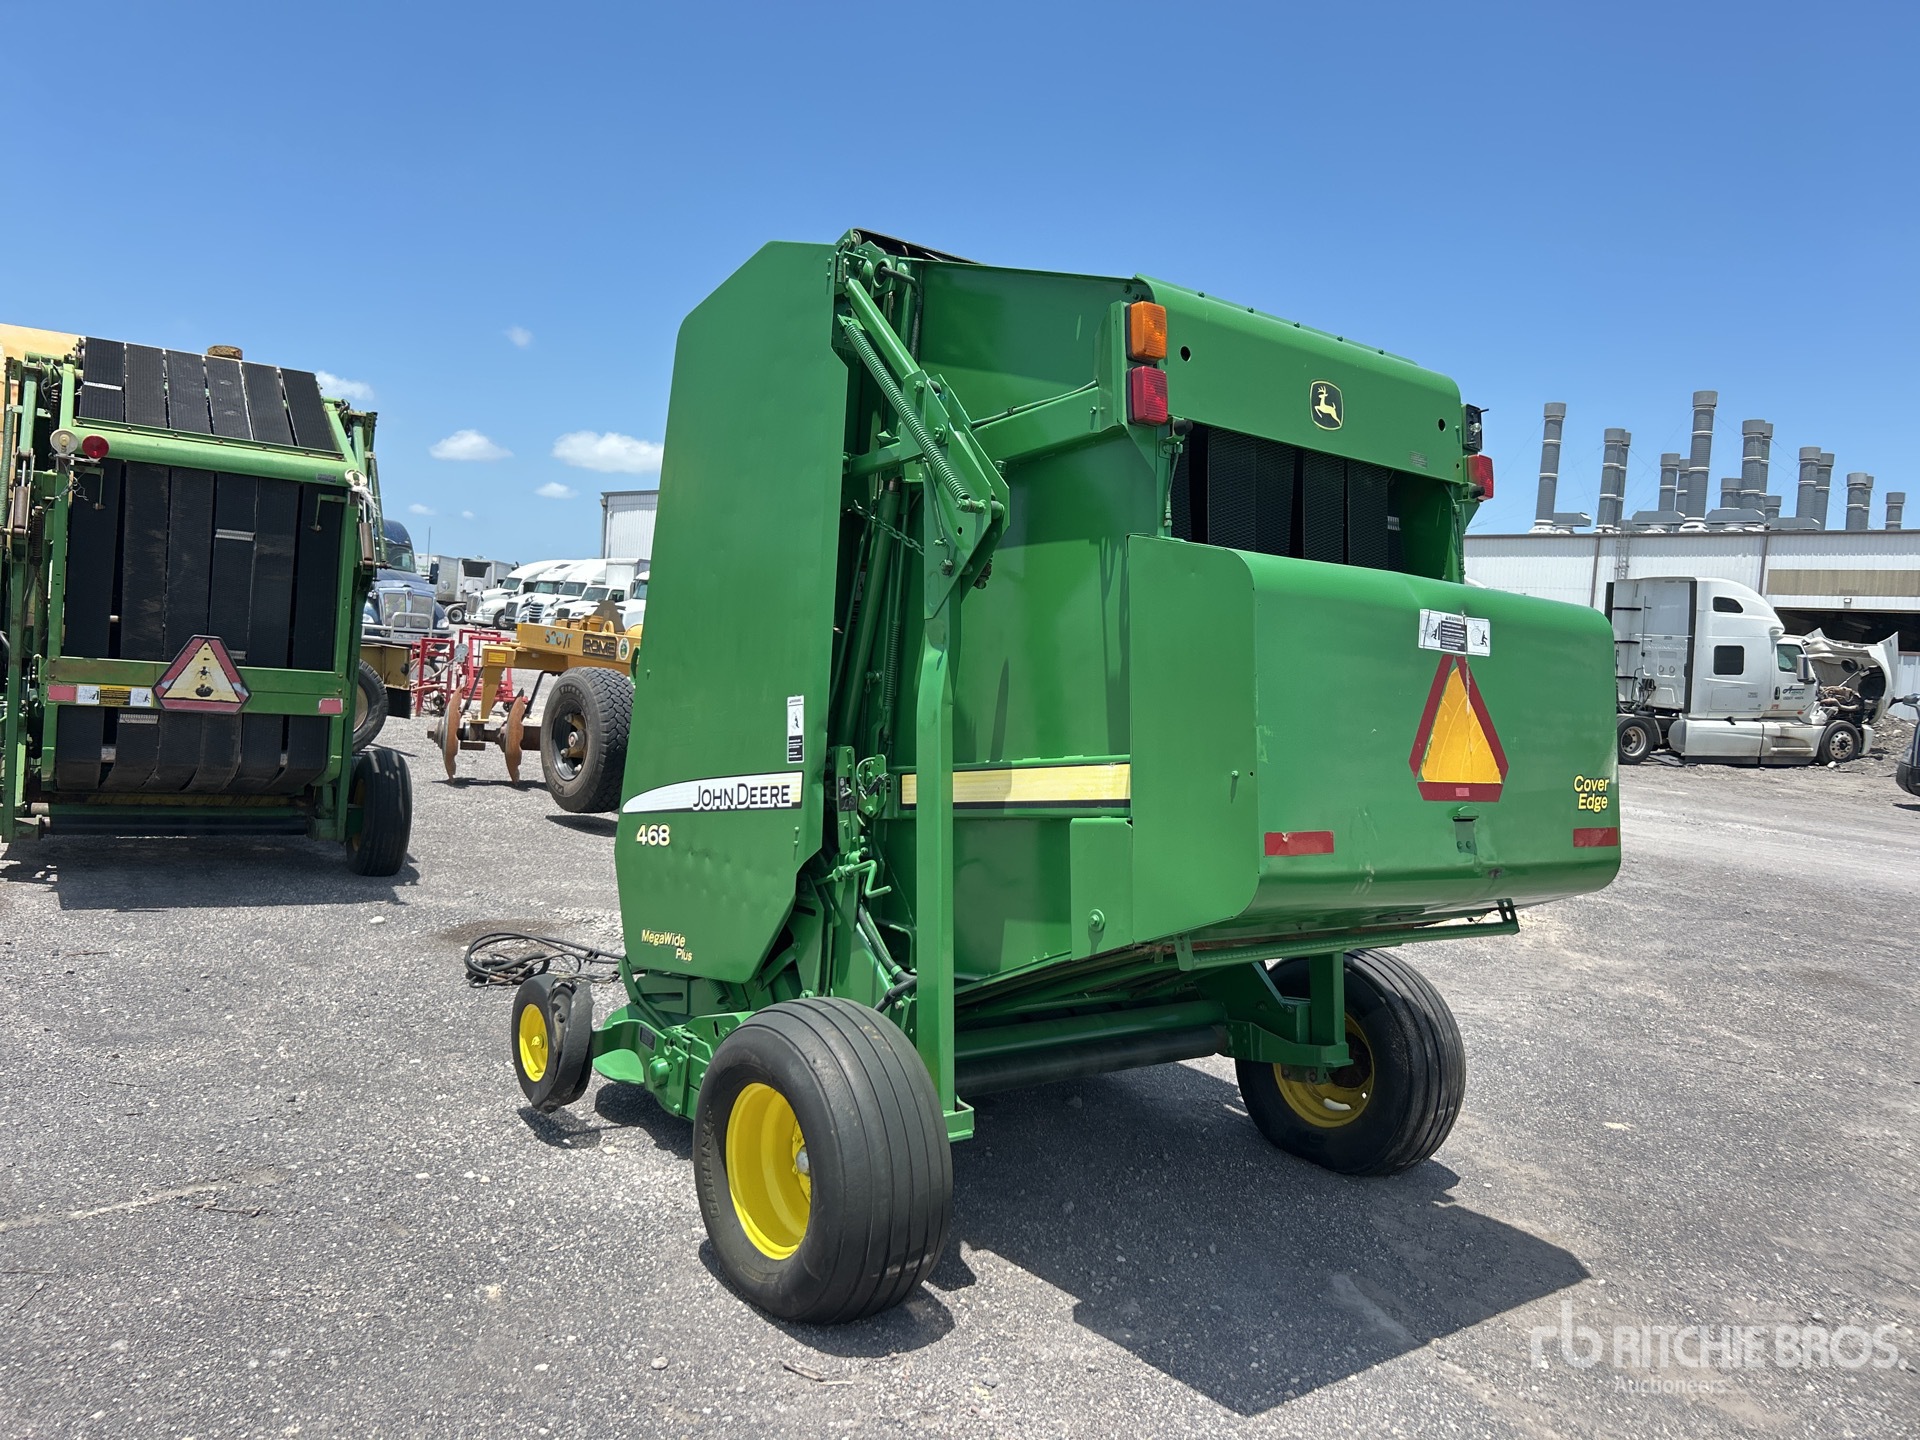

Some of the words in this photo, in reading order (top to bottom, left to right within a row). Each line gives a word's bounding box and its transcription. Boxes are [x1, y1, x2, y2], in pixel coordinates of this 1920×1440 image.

[584, 637, 615, 656] ROME
[1574, 775, 1610, 792] Cover
[693, 785, 734, 808] JOHN
[737, 783, 791, 806] DEERE
[1578, 793, 1608, 812] Edge
[636, 824, 670, 846] 468
[641, 929, 686, 947] MegaWide
[675, 947, 693, 962] Plus
